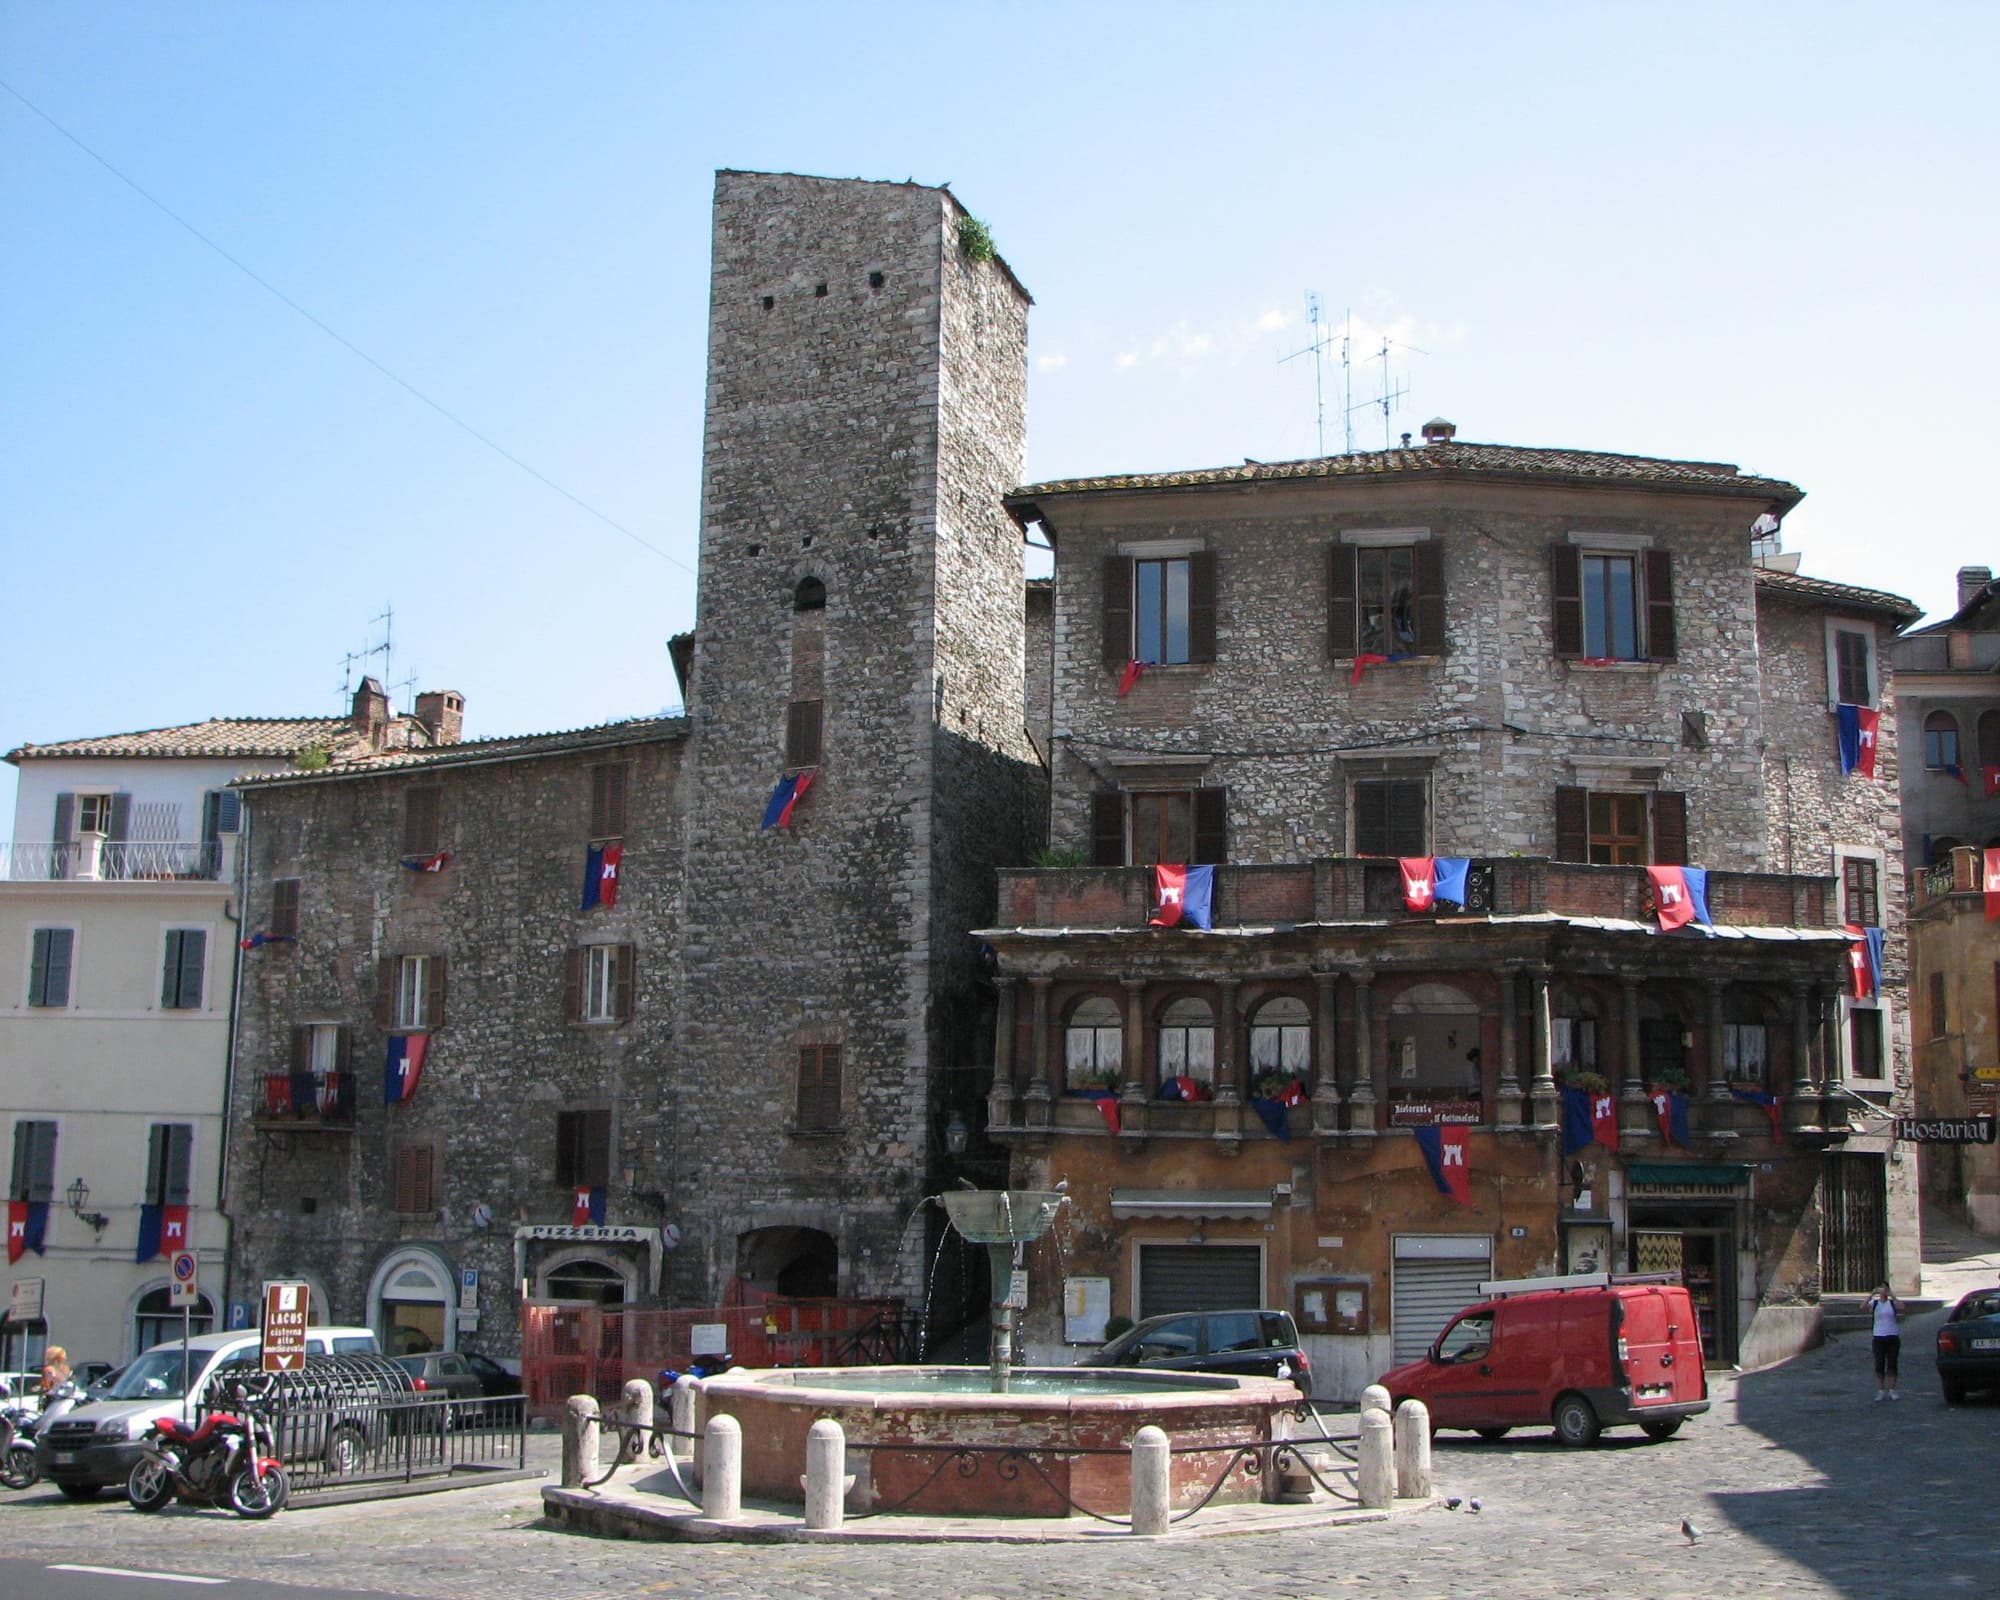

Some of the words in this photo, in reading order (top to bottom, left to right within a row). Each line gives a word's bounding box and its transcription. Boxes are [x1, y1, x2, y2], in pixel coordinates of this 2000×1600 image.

[1902, 1120, 1979, 1140] Hostaria
[533, 1227, 637, 1238] PIZZERIA
[271, 1312, 303, 1325] LACUS
[270, 1328, 302, 1337] cisterna
